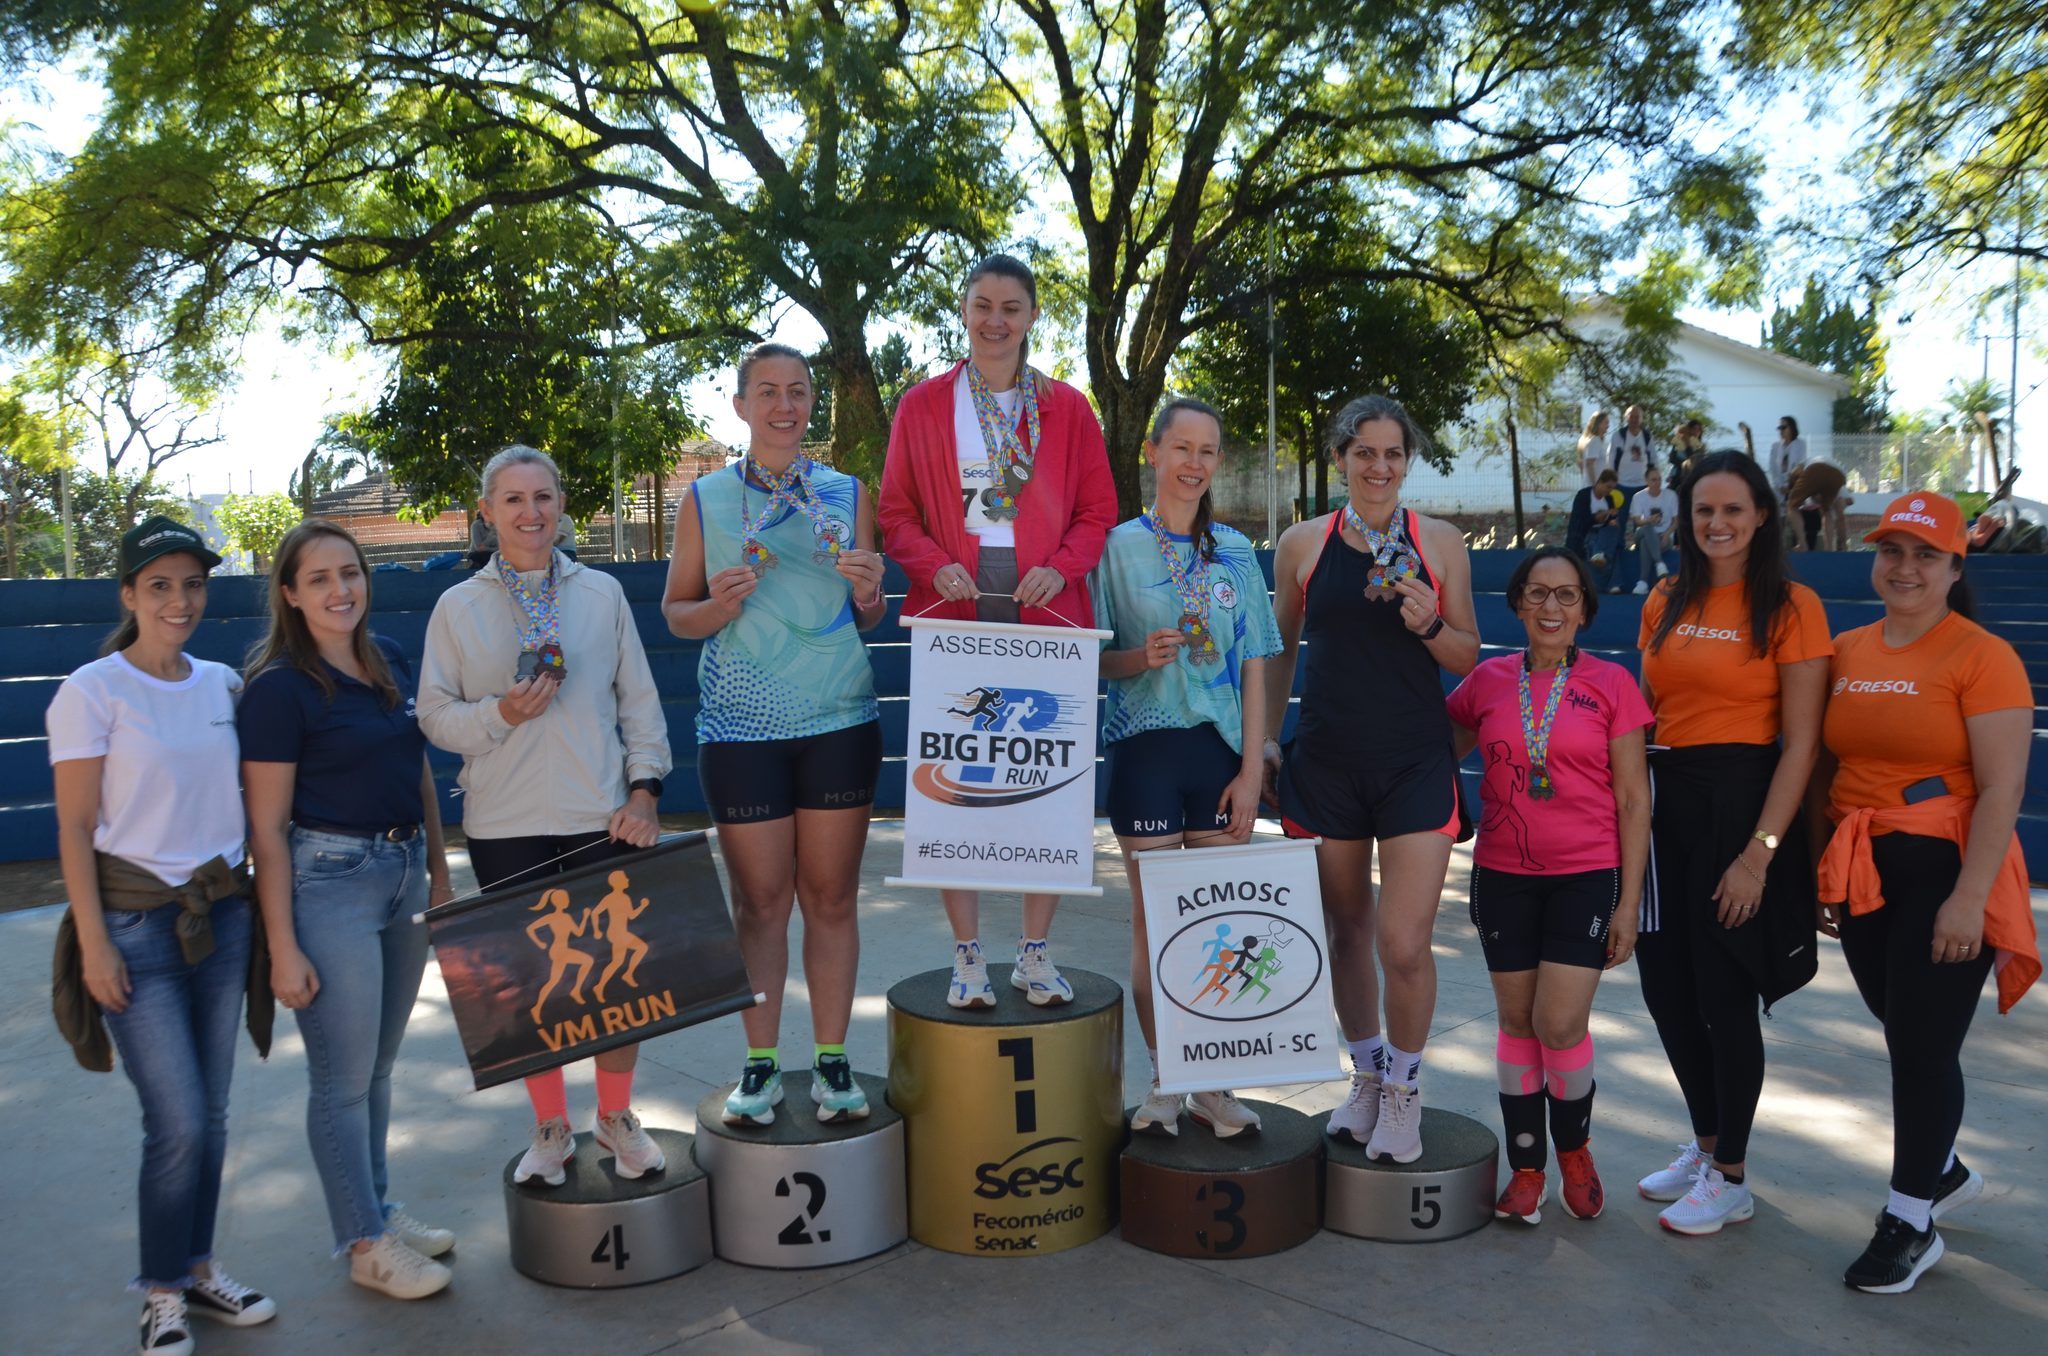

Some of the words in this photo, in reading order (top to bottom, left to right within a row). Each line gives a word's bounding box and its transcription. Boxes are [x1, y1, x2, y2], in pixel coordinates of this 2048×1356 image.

[1889, 512, 1939, 529] CRESOL
[1675, 623, 1742, 642] CRESOL
[929, 635, 1082, 661] ASSESSORIA
[1848, 680, 1920, 695] CRESOL
[919, 731, 978, 763] BIG
[988, 736, 1076, 768] FORT
[1005, 767, 1049, 787] RUN
[727, 804, 770, 819] RUN
[1133, 819, 1168, 832] RUN
[918, 840, 1079, 866] #ÉSÓNÃOPARAR
[1177, 880, 1291, 916] ACMOSC
[537, 1016, 597, 1053] VM
[601, 989, 678, 1036] RUN
[1183, 1032, 1273, 1063] MONDAÍ
[1292, 1033, 1318, 1053] SC
[998, 1037, 1037, 1134] 1
[774, 1171, 832, 1246] 2
[973, 1204, 1085, 1229] Fecomércio
[1195, 1180, 1248, 1253] 3
[1410, 1184, 1442, 1230] 5
[590, 1223, 631, 1271] 4
[974, 1234, 1038, 1251] Senac
